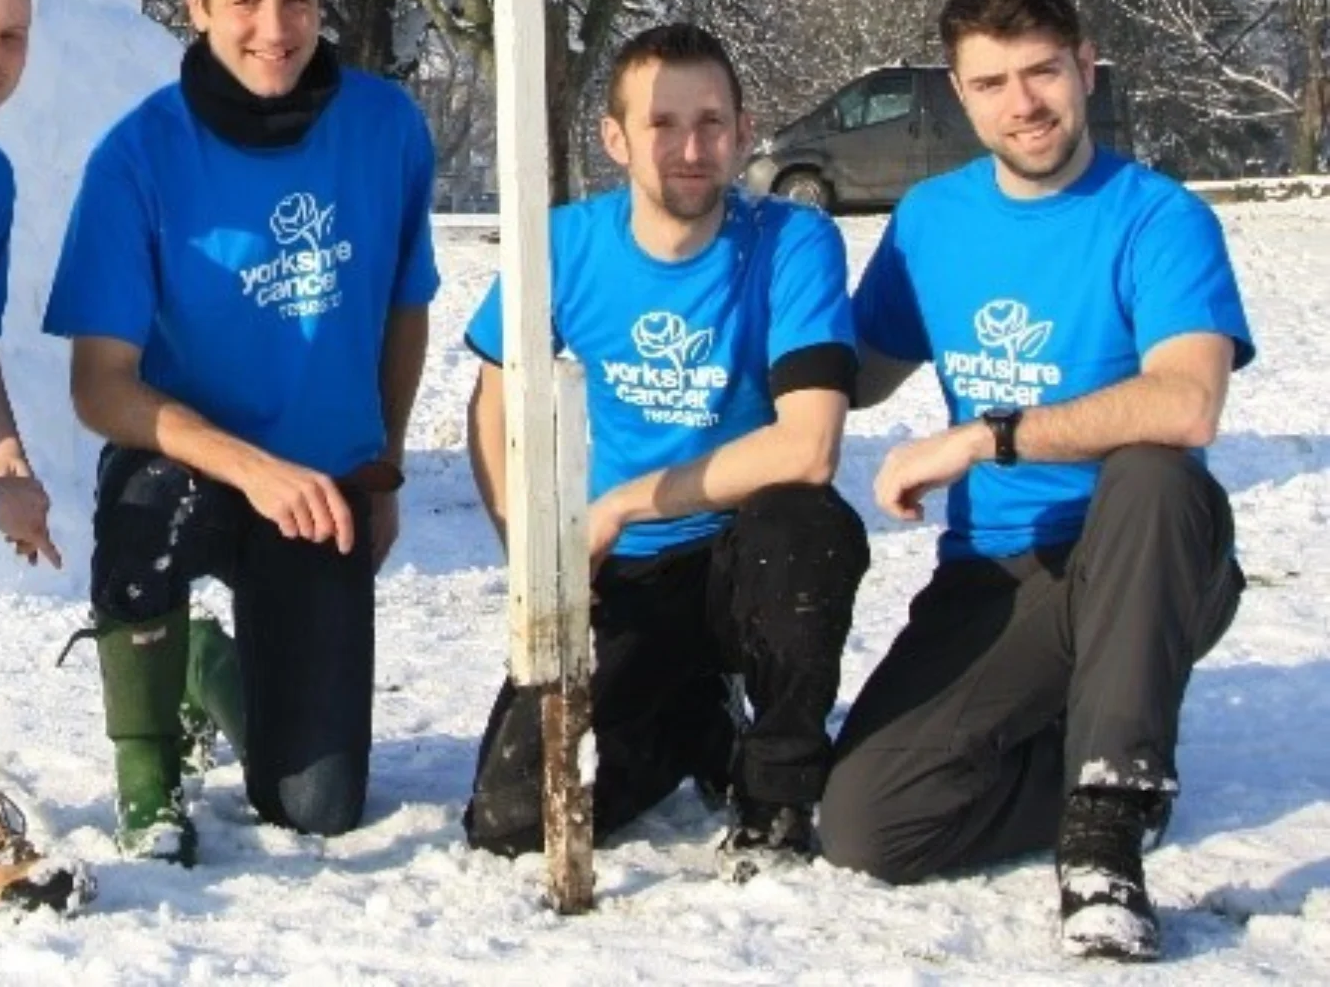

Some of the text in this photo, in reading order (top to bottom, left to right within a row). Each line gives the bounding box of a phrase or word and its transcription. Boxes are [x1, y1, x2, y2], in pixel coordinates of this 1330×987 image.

[239, 240, 352, 295] yorkshe
[256, 269, 337, 307] cance
[601, 360, 728, 388] yorkshire
[944, 351, 1061, 386] yorkshire
[616, 385, 710, 408] cancer
[954, 377, 1043, 407] cancer
